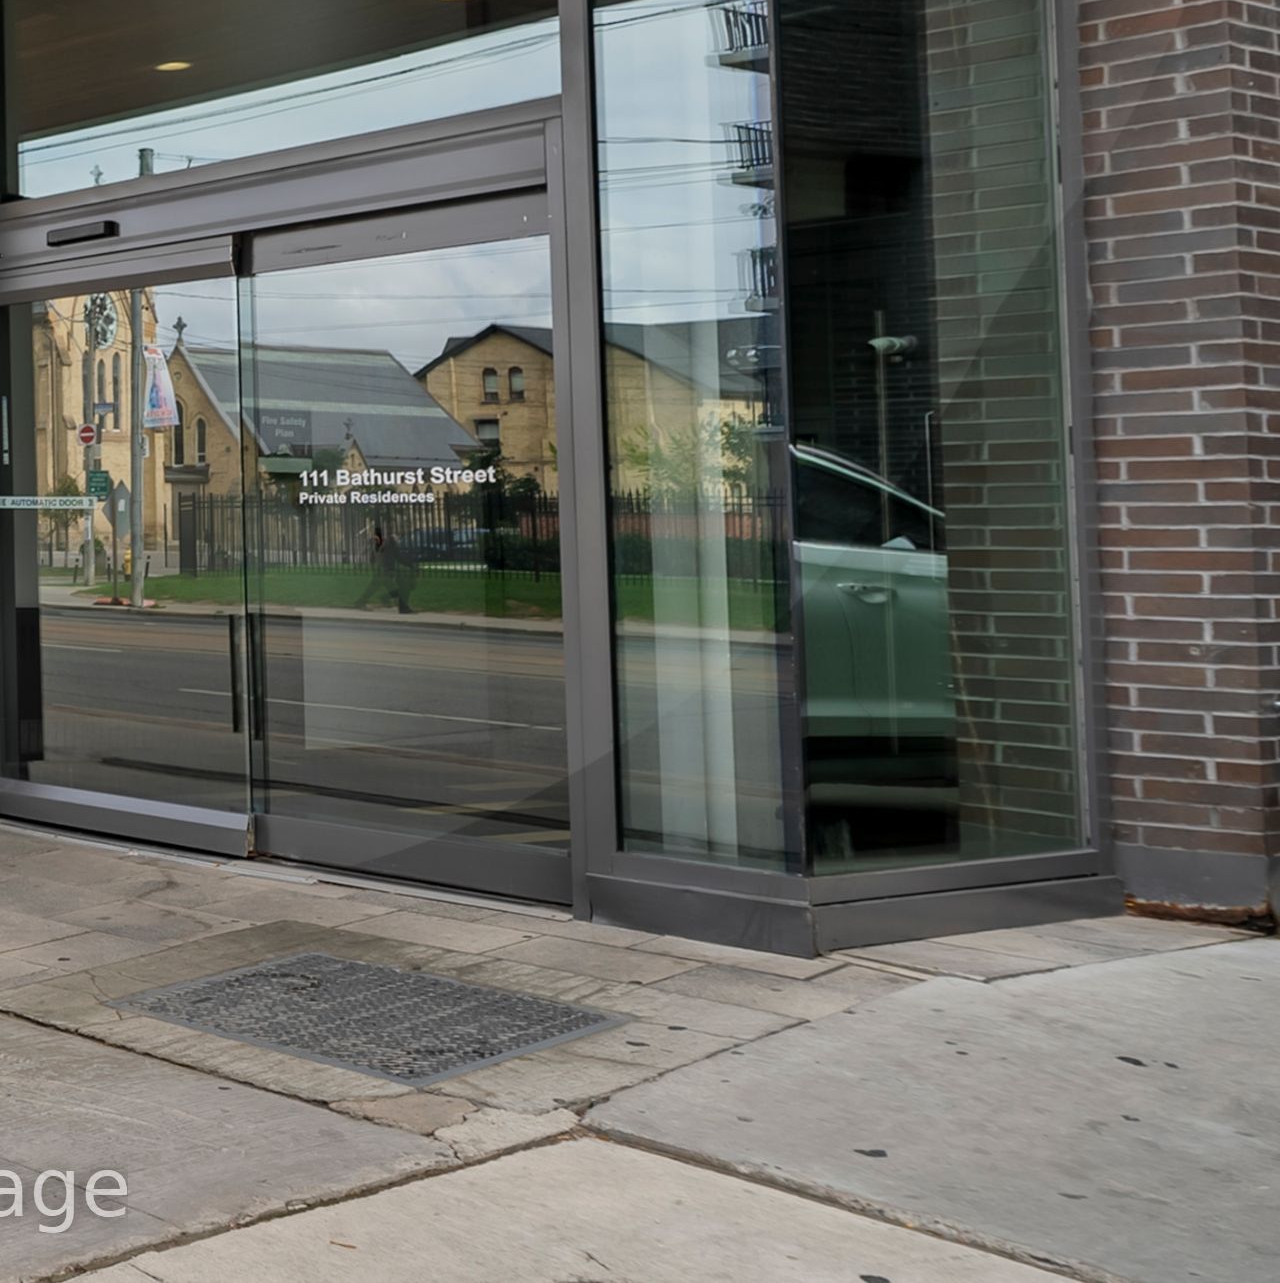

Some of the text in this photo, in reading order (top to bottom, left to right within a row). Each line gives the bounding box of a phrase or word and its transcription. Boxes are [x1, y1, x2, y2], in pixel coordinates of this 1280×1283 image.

[299, 466, 496, 487] 111 Bathurst Street
[11, 499, 84, 507] AUTOMATIC DOOR
[299, 491, 435, 504] Private Residences
